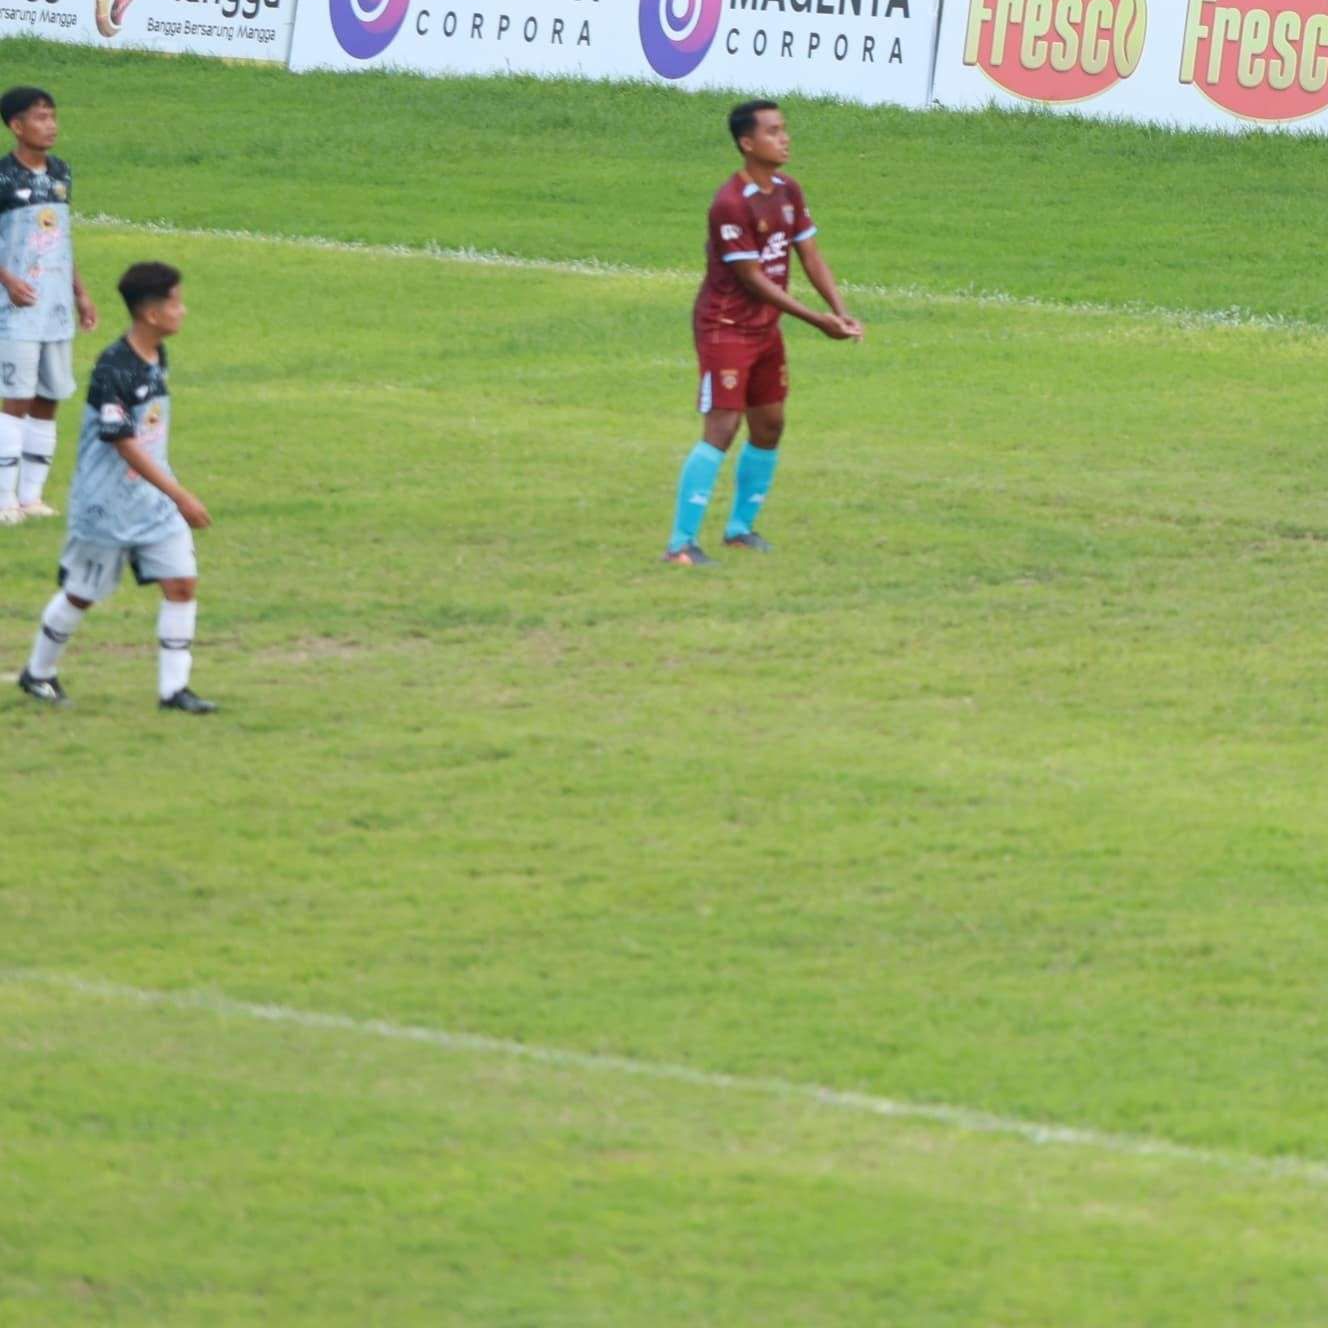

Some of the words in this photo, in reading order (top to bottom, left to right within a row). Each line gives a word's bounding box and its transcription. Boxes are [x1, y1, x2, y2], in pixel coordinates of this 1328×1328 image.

[184, 19, 235, 40] Bersarung
[237, 26, 276, 43] Mangga
[416, 9, 592, 47] CORPORA
[726, 27, 903, 64] CORPORA
